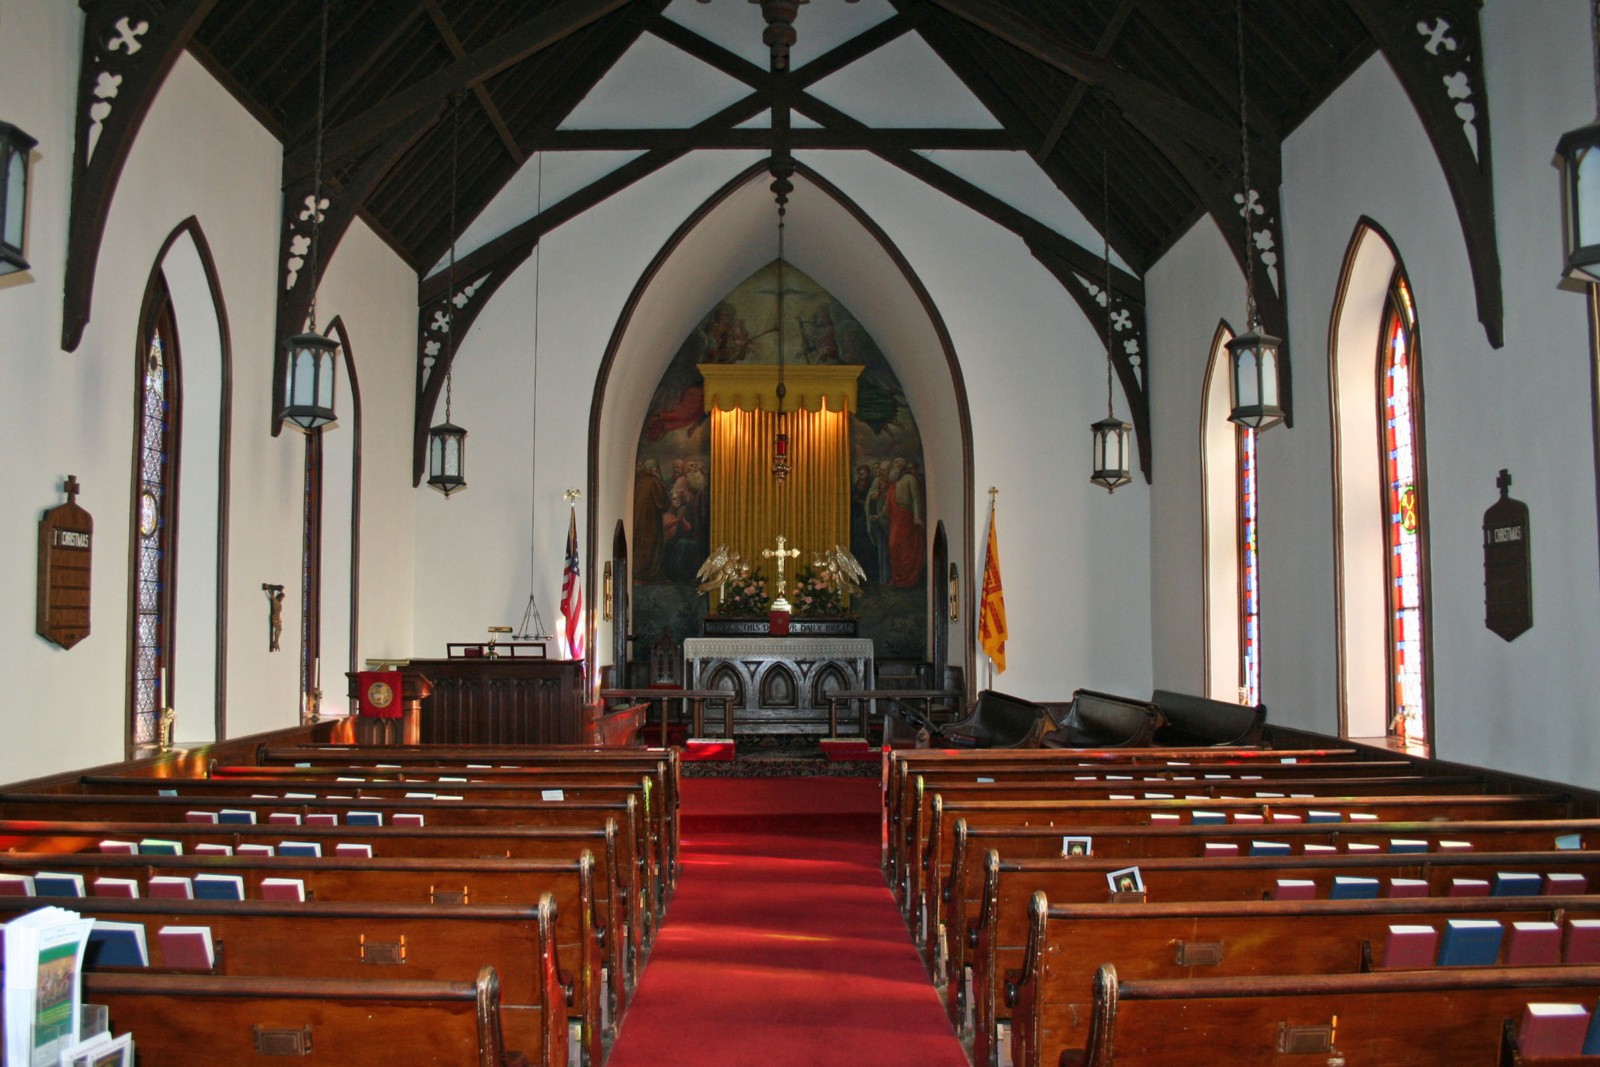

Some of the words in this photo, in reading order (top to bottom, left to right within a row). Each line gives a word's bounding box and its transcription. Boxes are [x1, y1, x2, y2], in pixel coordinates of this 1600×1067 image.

[61, 531, 88, 547] CHRISTMAS
[1494, 526, 1520, 542] CHRISTMAS
[800, 623, 821, 632] DAILY
